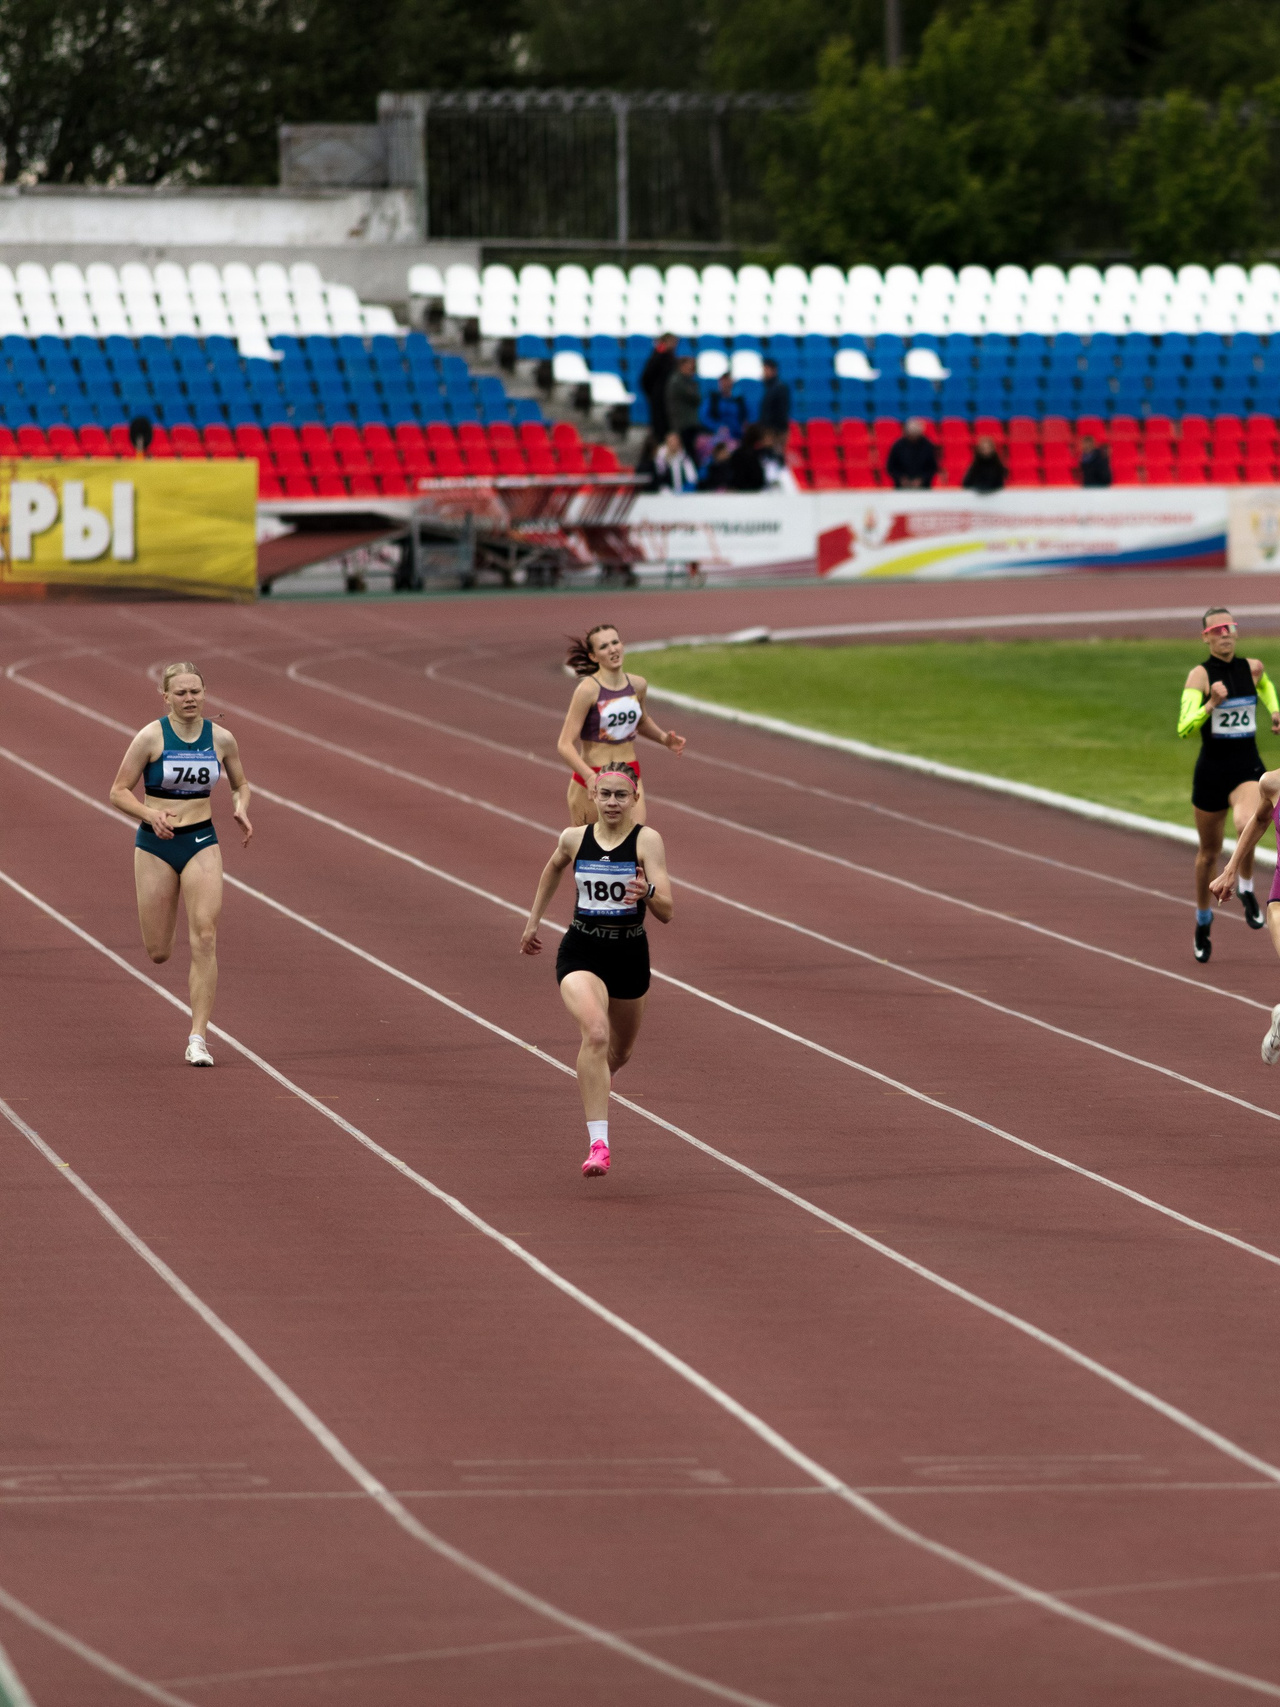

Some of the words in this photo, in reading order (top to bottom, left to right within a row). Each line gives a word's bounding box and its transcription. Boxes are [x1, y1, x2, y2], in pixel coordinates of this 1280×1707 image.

[0, 480, 134, 559] РЫ
[607, 710, 637, 727] 299
[1219, 710, 1250, 727] 226
[172, 767, 210, 785] 748
[583, 880, 626, 902] 180
